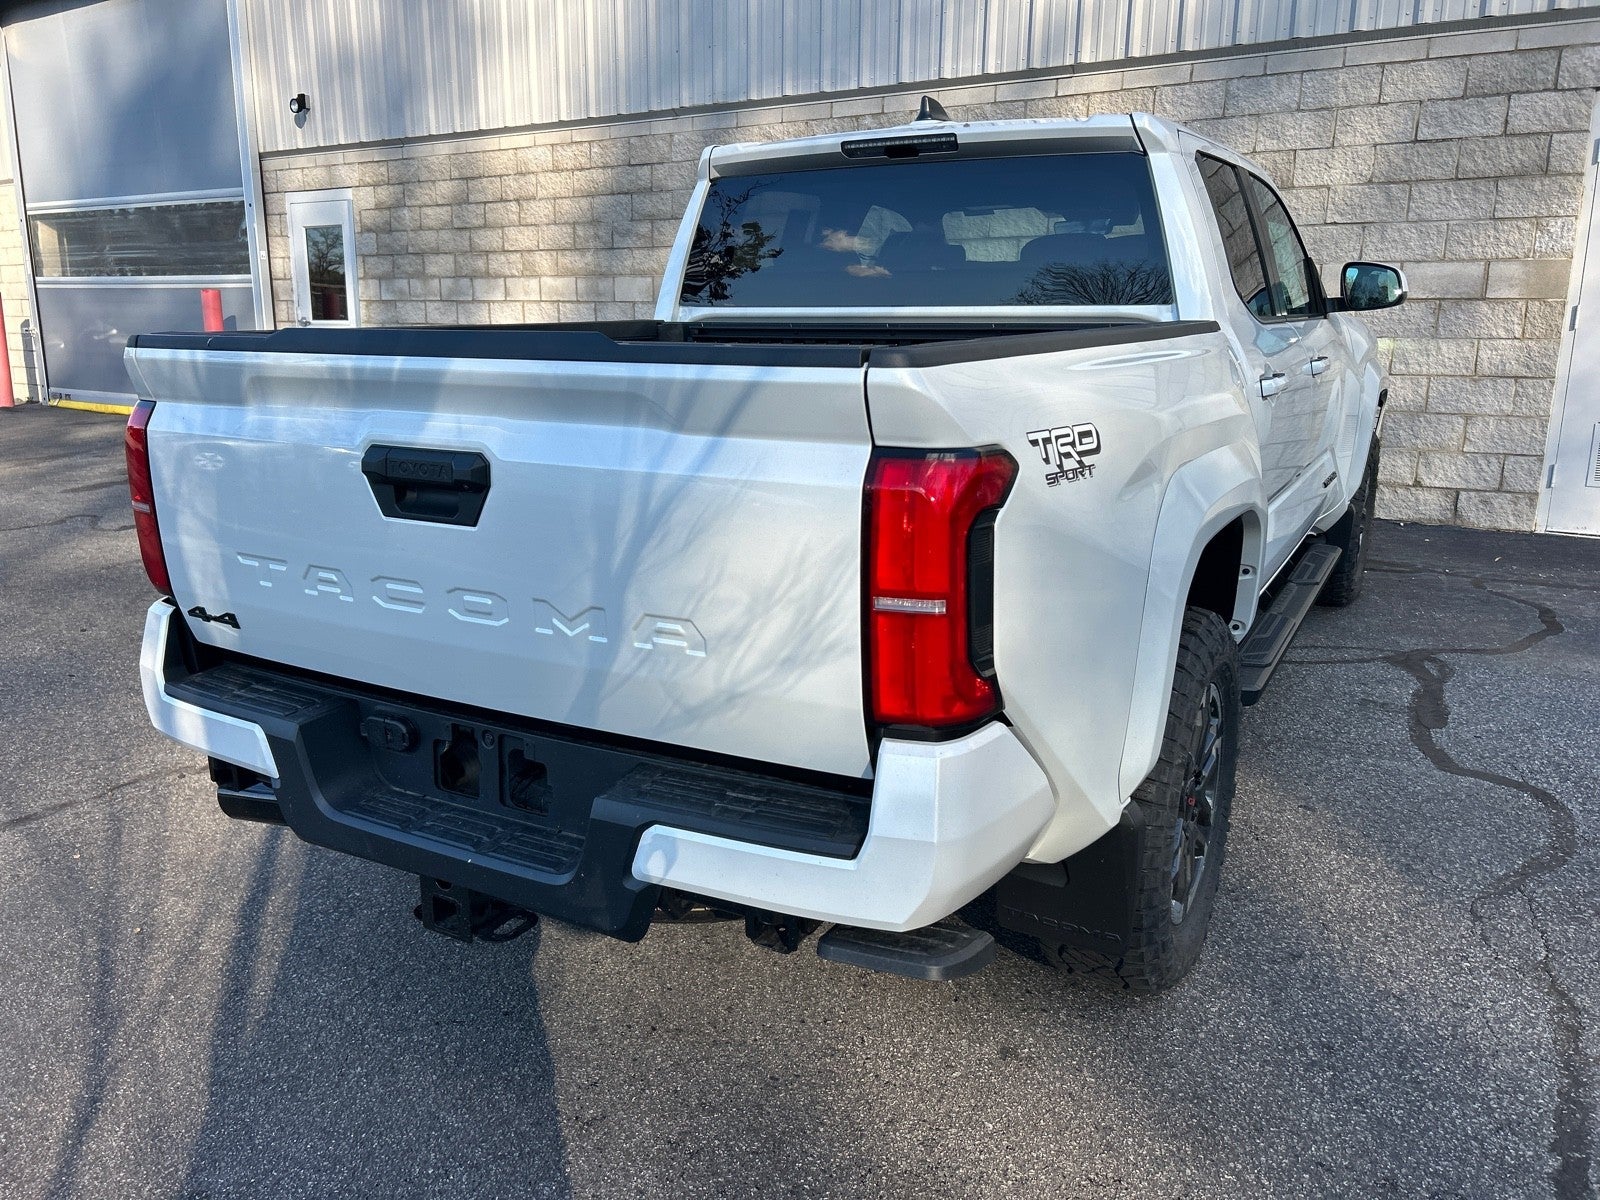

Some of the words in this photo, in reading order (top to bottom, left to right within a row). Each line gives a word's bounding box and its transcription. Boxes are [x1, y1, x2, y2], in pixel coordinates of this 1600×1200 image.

[1026, 422, 1101, 472] TRD
[390, 460, 449, 480] TOYOTA
[1045, 463, 1096, 487] SPORT
[236, 552, 707, 658] TACOMA
